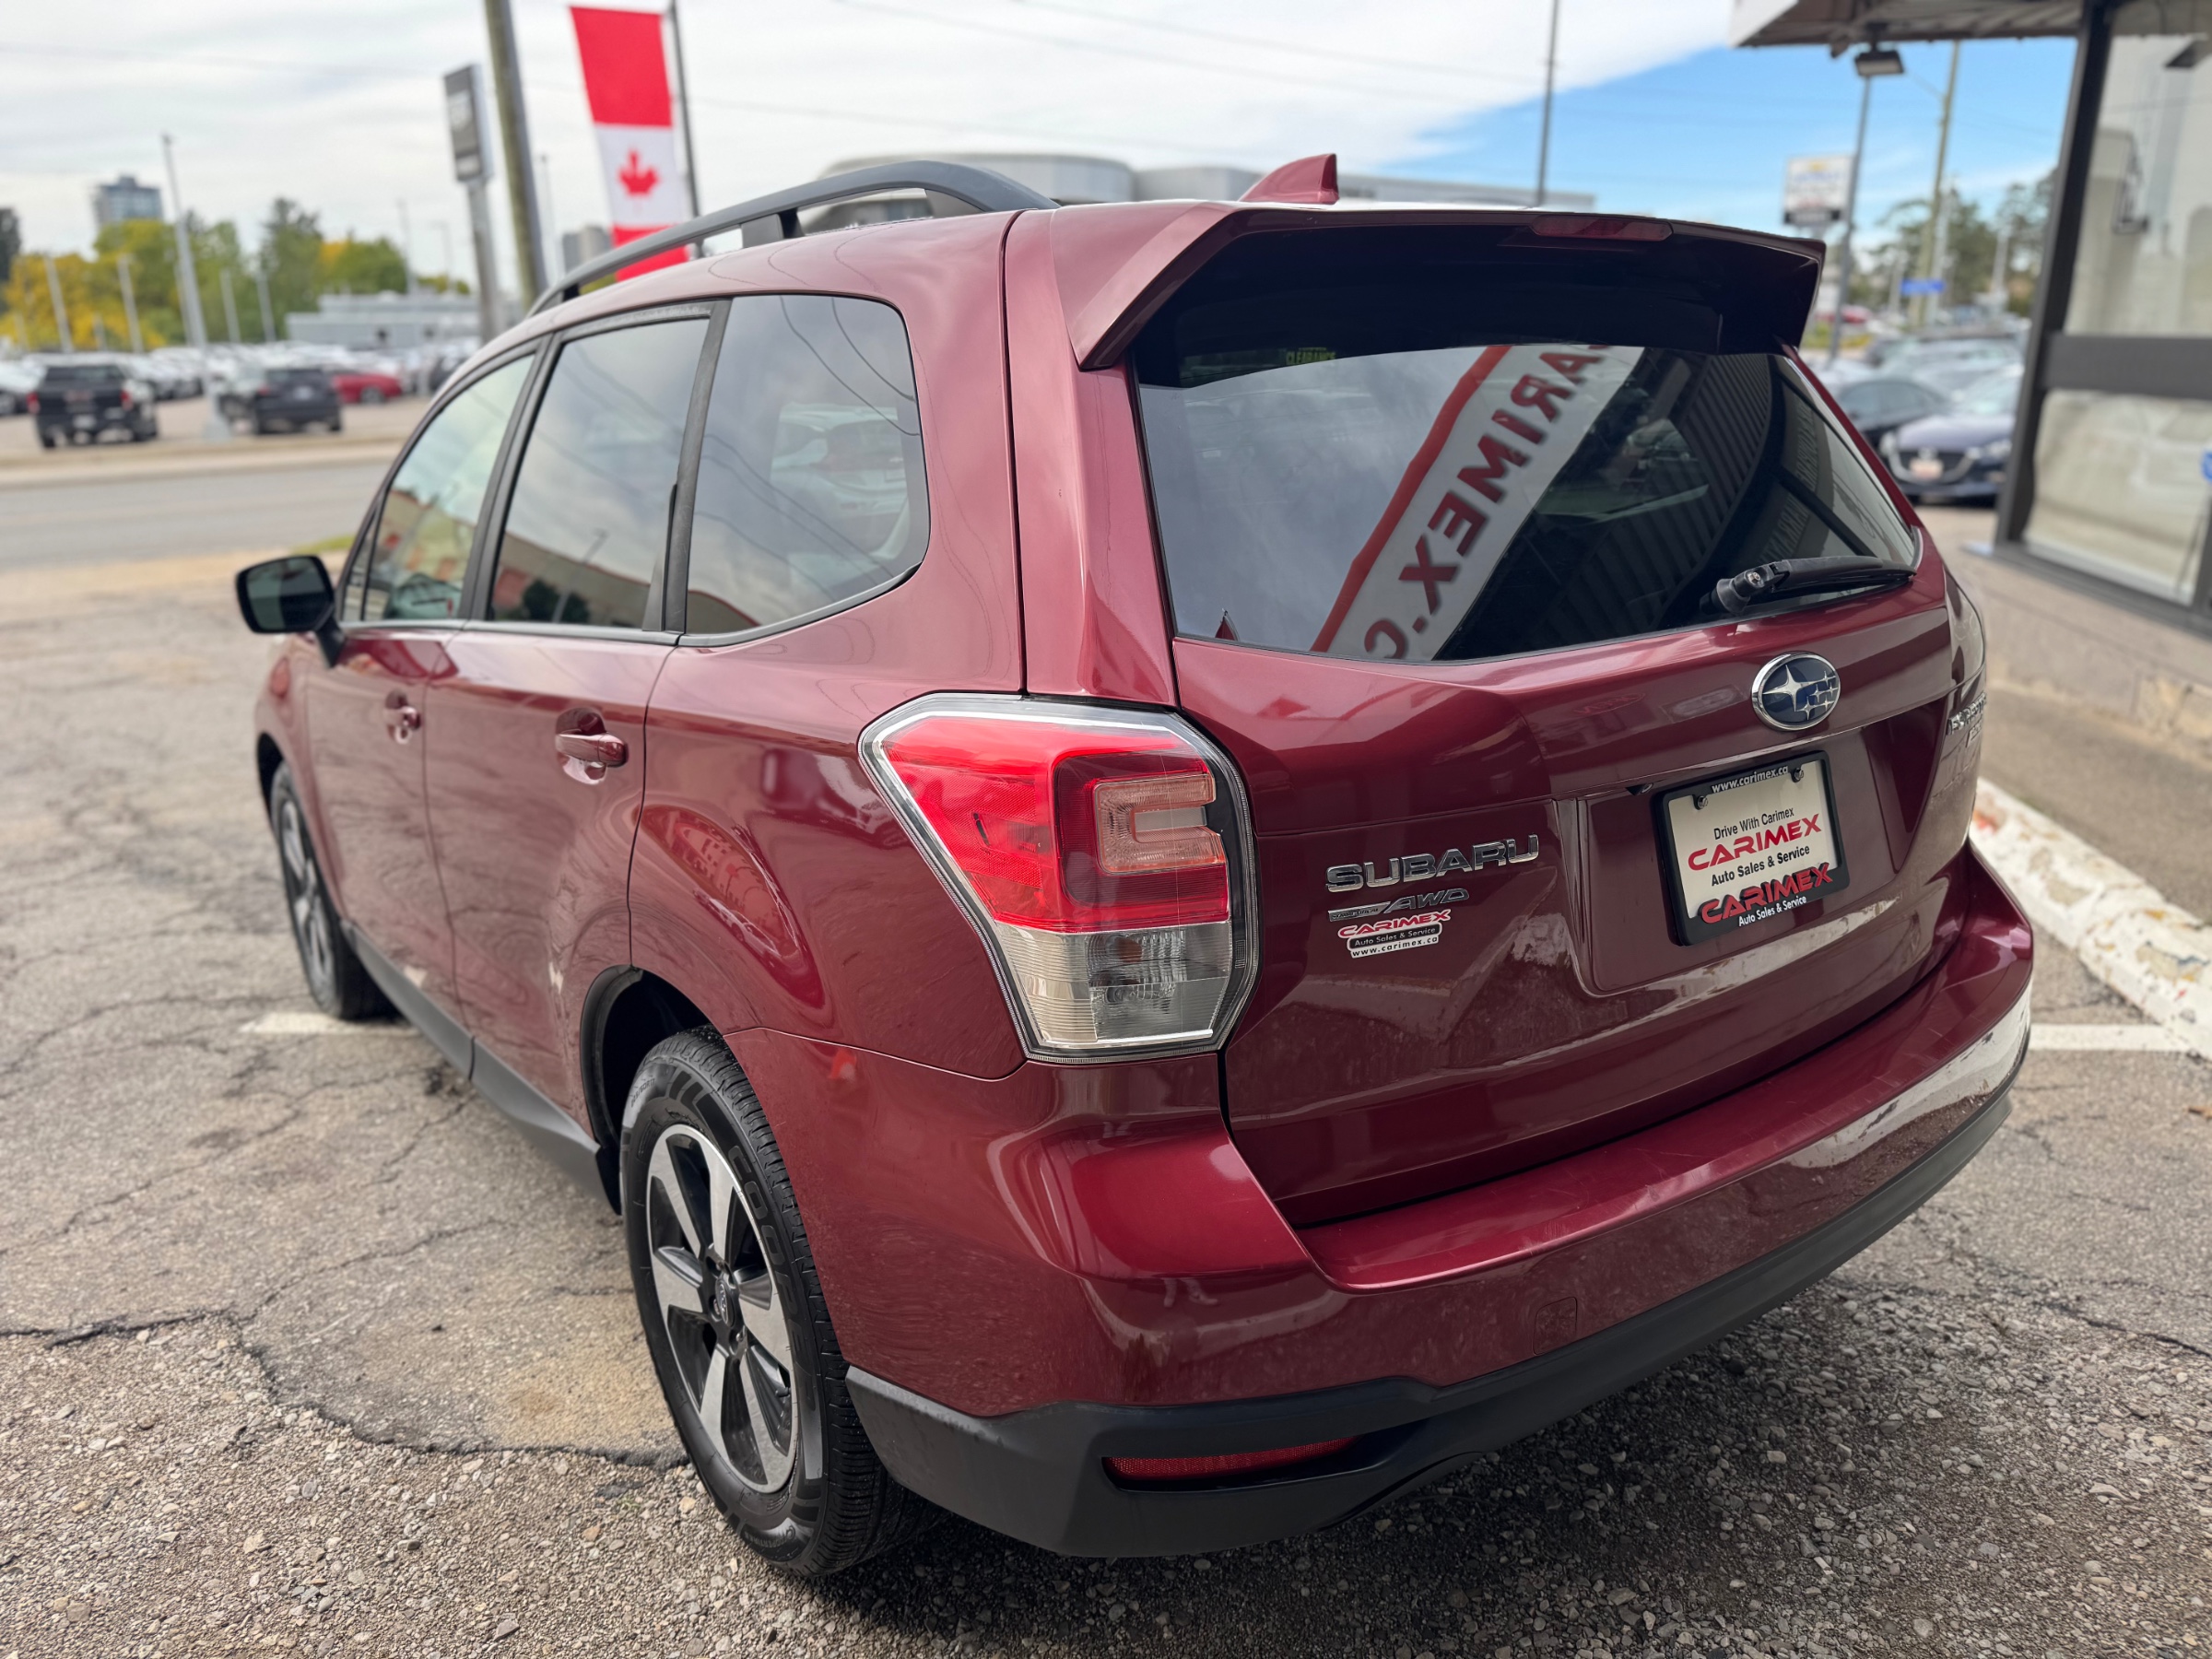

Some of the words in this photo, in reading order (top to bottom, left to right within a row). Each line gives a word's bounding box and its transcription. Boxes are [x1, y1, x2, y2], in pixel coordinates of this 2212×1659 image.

[1712, 766, 1789, 794] www.carimex.ca
[1713, 824, 1738, 840] Drive
[1739, 817, 1759, 832] With
[1761, 807, 1794, 825] Carimex
[1688, 814, 1821, 871] CARIMEX
[1325, 834, 1539, 893] SUBARU
[1712, 869, 1735, 887] Auto
[1737, 861, 1765, 877] Sales
[1767, 855, 1775, 868] &
[1777, 844, 1810, 865] Service
[1383, 888, 1470, 913] AWD
[1700, 863, 1832, 924] CARIMEX
[1338, 910, 1451, 936] CARIMEX
[1738, 913, 1756, 927] Auto
[1756, 907, 1775, 923] Sales
[1776, 902, 1783, 912] &
[1783, 895, 1806, 912] Service
[1352, 936, 1438, 958] www.carimex.ca
[1354, 938, 1374, 947] Auto
[1376, 935, 1397, 944] Sales
[1407, 927, 1436, 937] Service
[728, 1145, 816, 1411] COOPER
